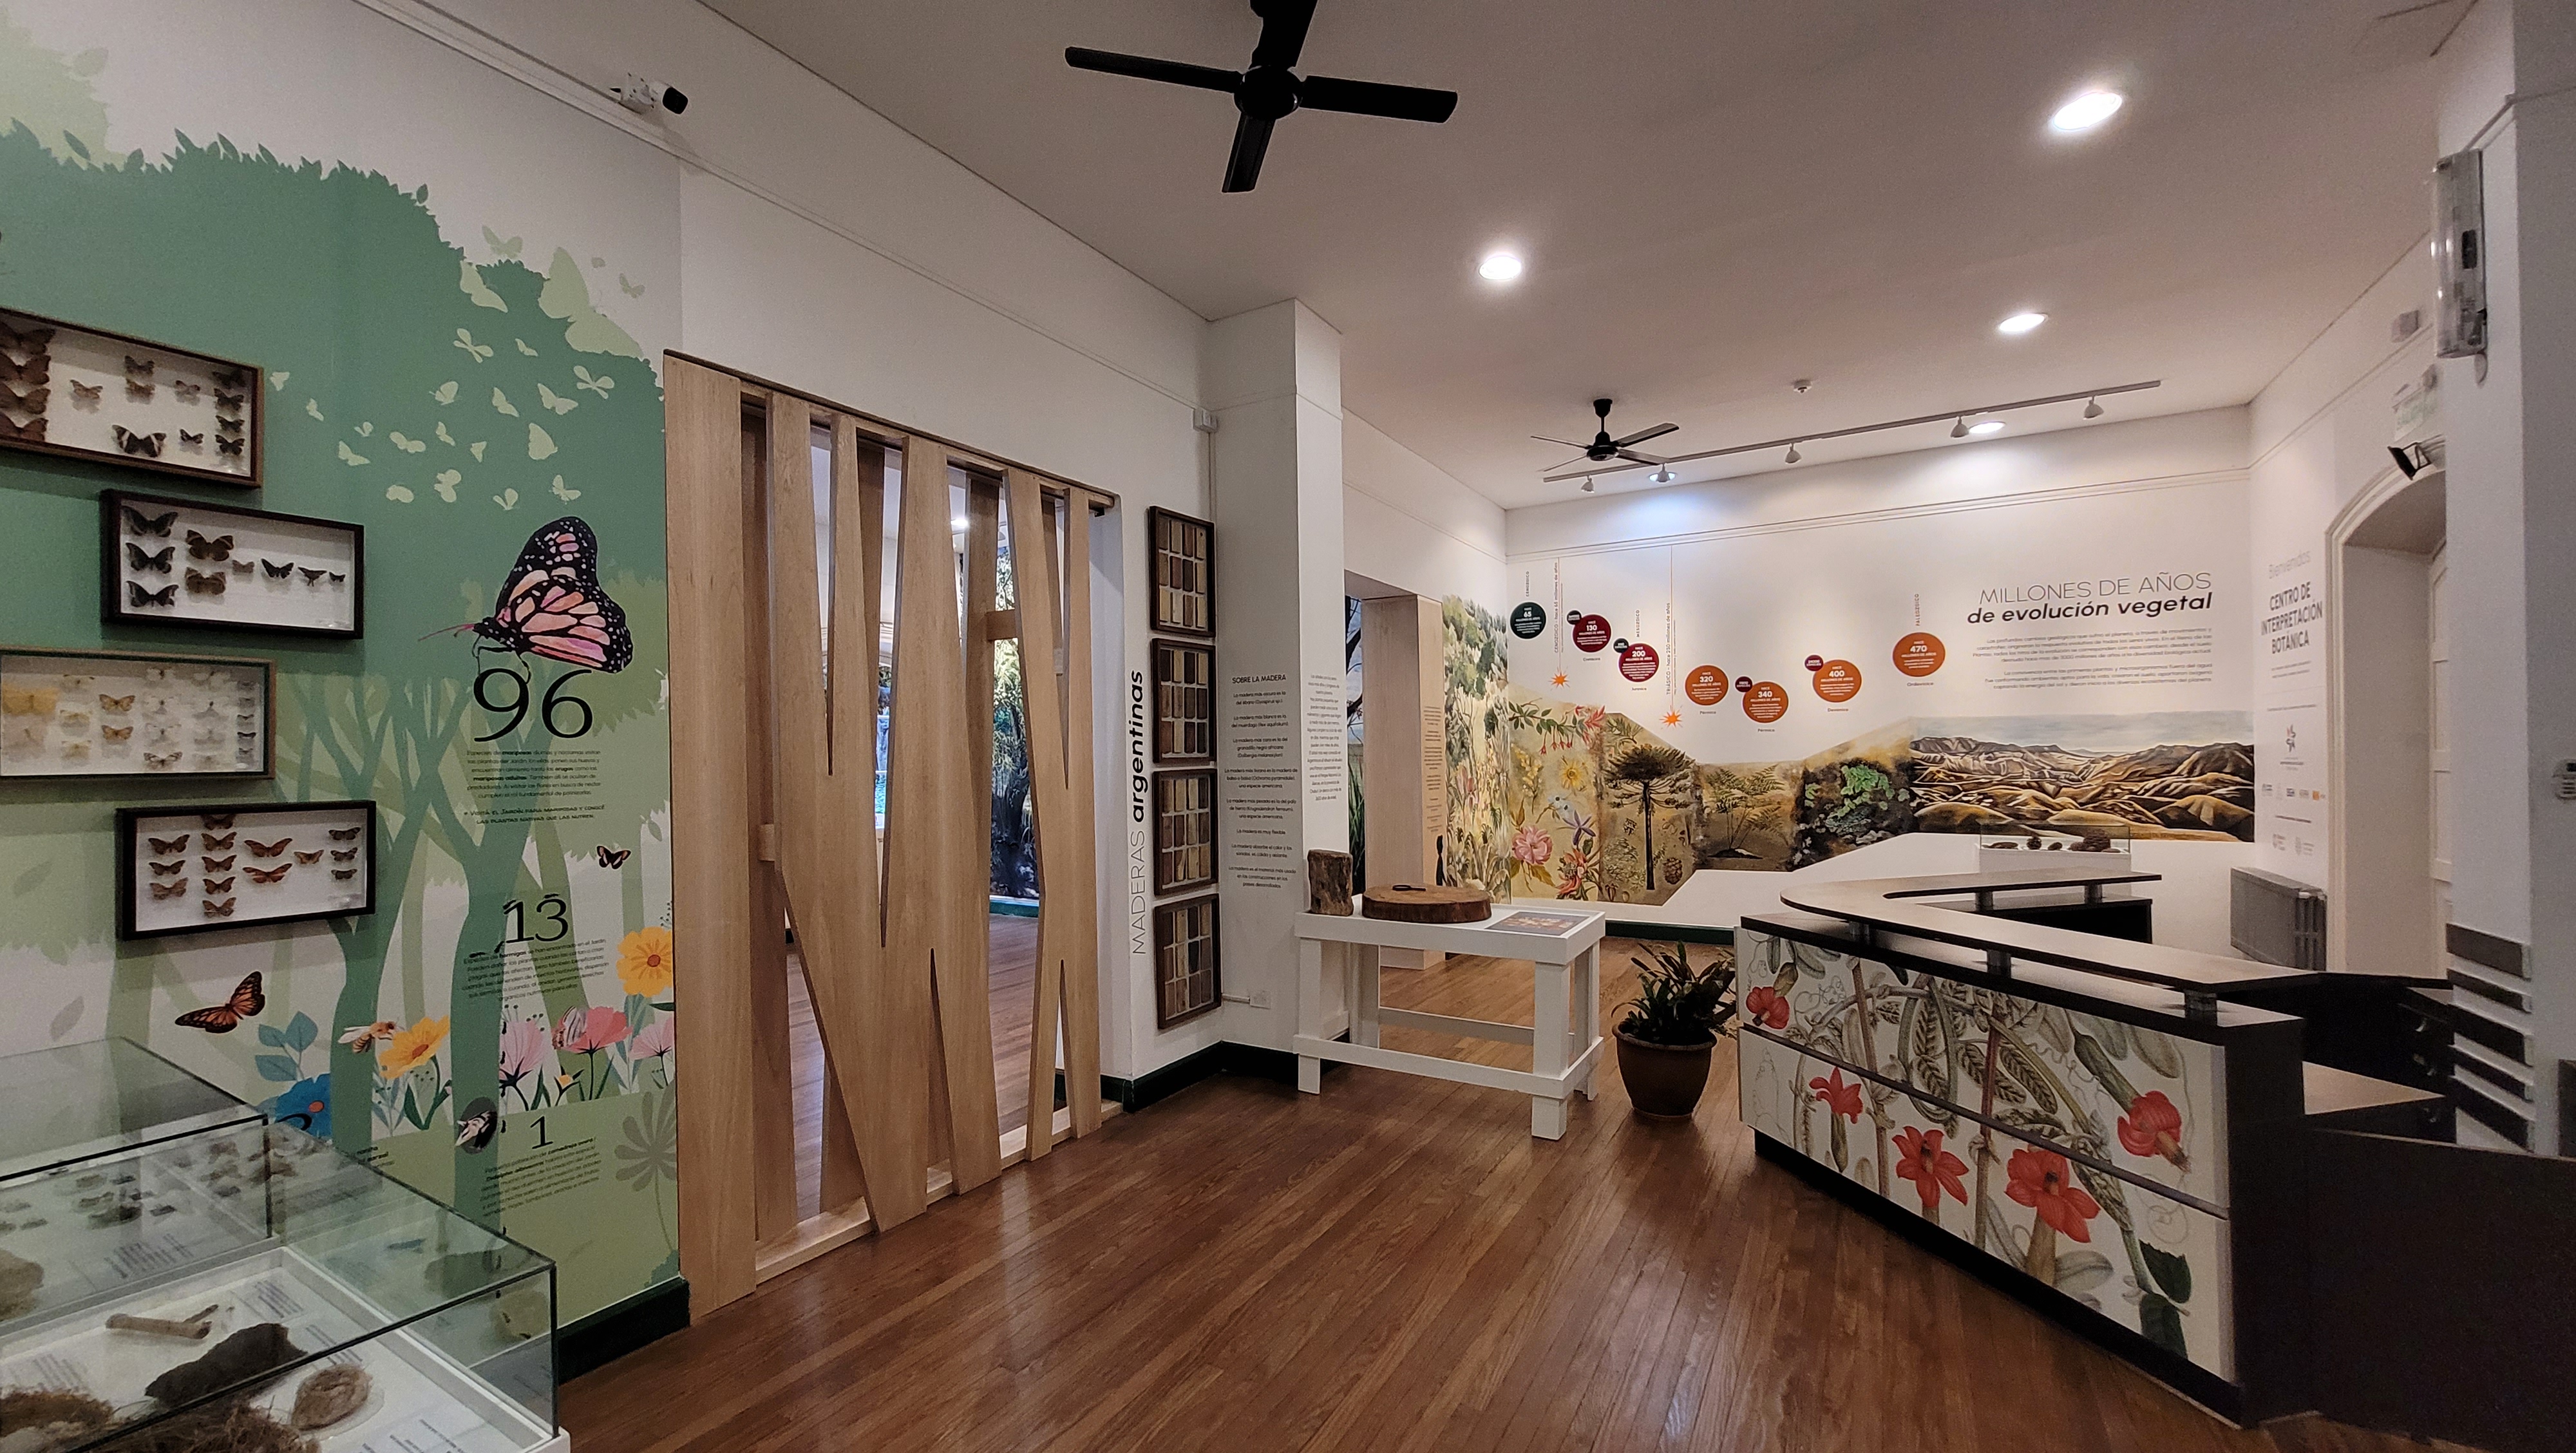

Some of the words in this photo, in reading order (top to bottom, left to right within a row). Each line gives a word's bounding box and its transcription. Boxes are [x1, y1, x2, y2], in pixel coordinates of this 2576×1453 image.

[1980, 582, 2091, 604] MILLONES
[2099, 578, 2130, 596] DE
[2139, 572, 2211, 594] AÑOS
[2269, 586, 2298, 611] CENTRO
[2301, 582, 2311, 600] DE
[1967, 607, 1995, 623] de
[2002, 602, 2109, 622] evolución
[2118, 592, 2212, 617] vegetal
[2261, 600, 2322, 635] INTERPRETACIÓN
[2272, 631, 2309, 654] BOTÁNICA
[473, 668, 592, 742] 96
[1128, 670, 1148, 822] argentinas
[1131, 830, 1146, 954] MADERAS
[504, 898, 569, 944] 13
[530, 1116, 553, 1149] 1
